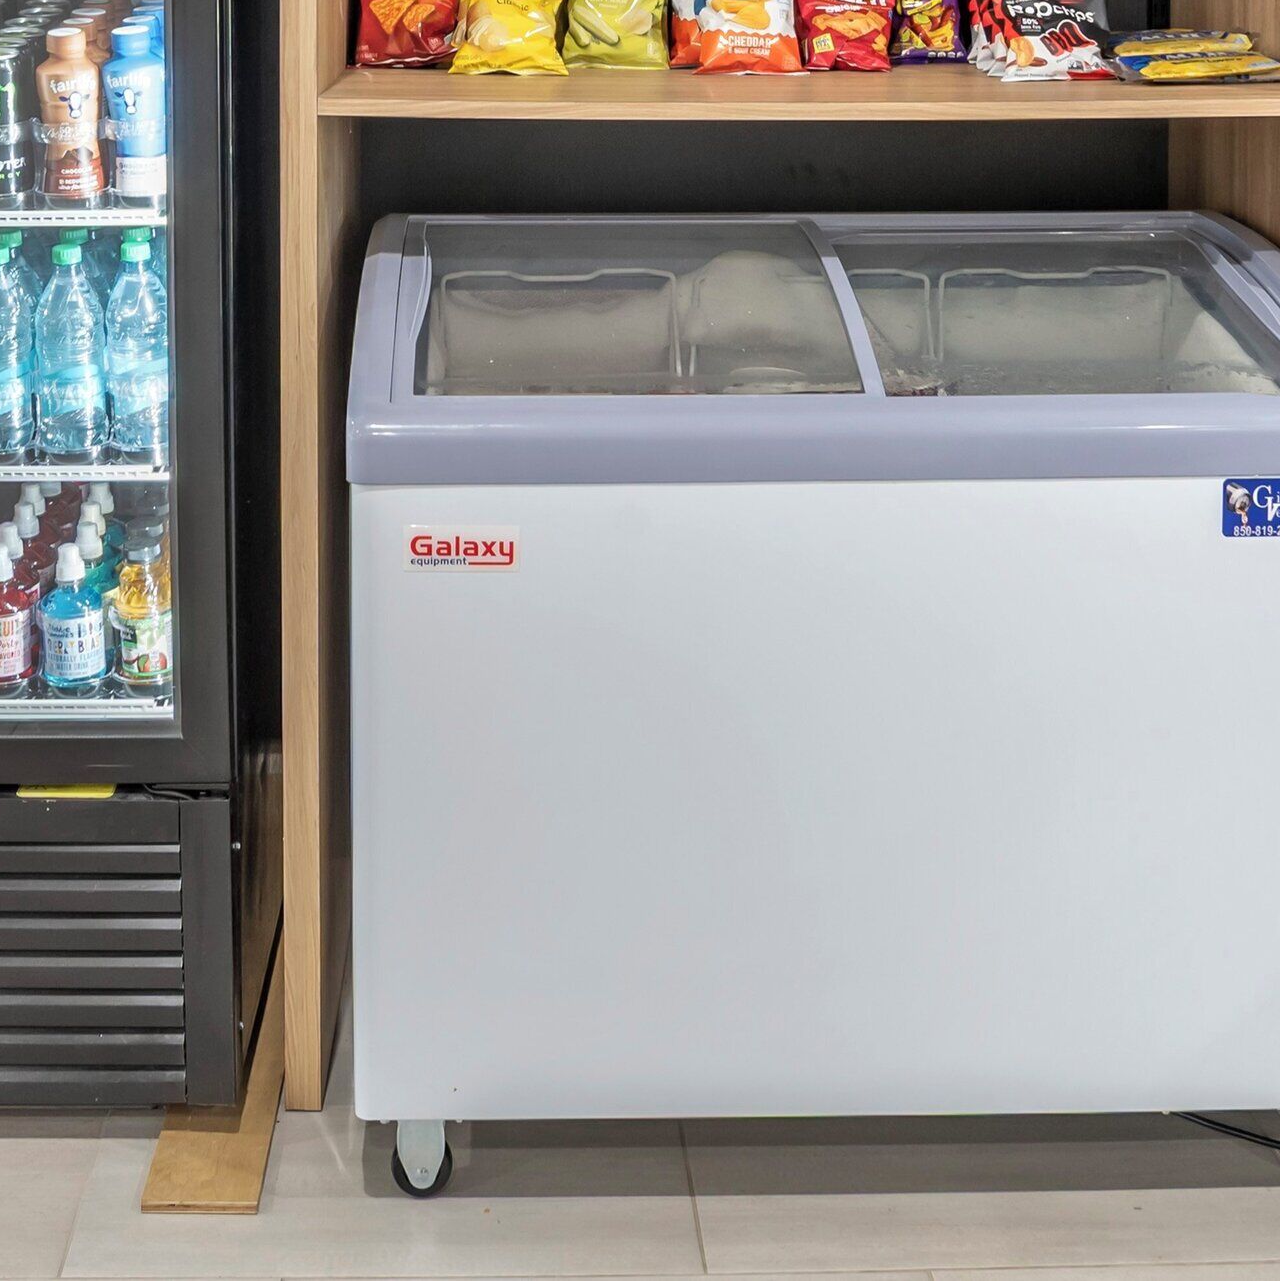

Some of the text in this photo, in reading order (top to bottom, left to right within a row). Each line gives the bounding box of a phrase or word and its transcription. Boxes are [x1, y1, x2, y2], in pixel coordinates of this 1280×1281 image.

[728, 35, 771, 48] CHEDDAR
[410, 535, 514, 566] Galaxy
[410, 556, 468, 567] equipment
